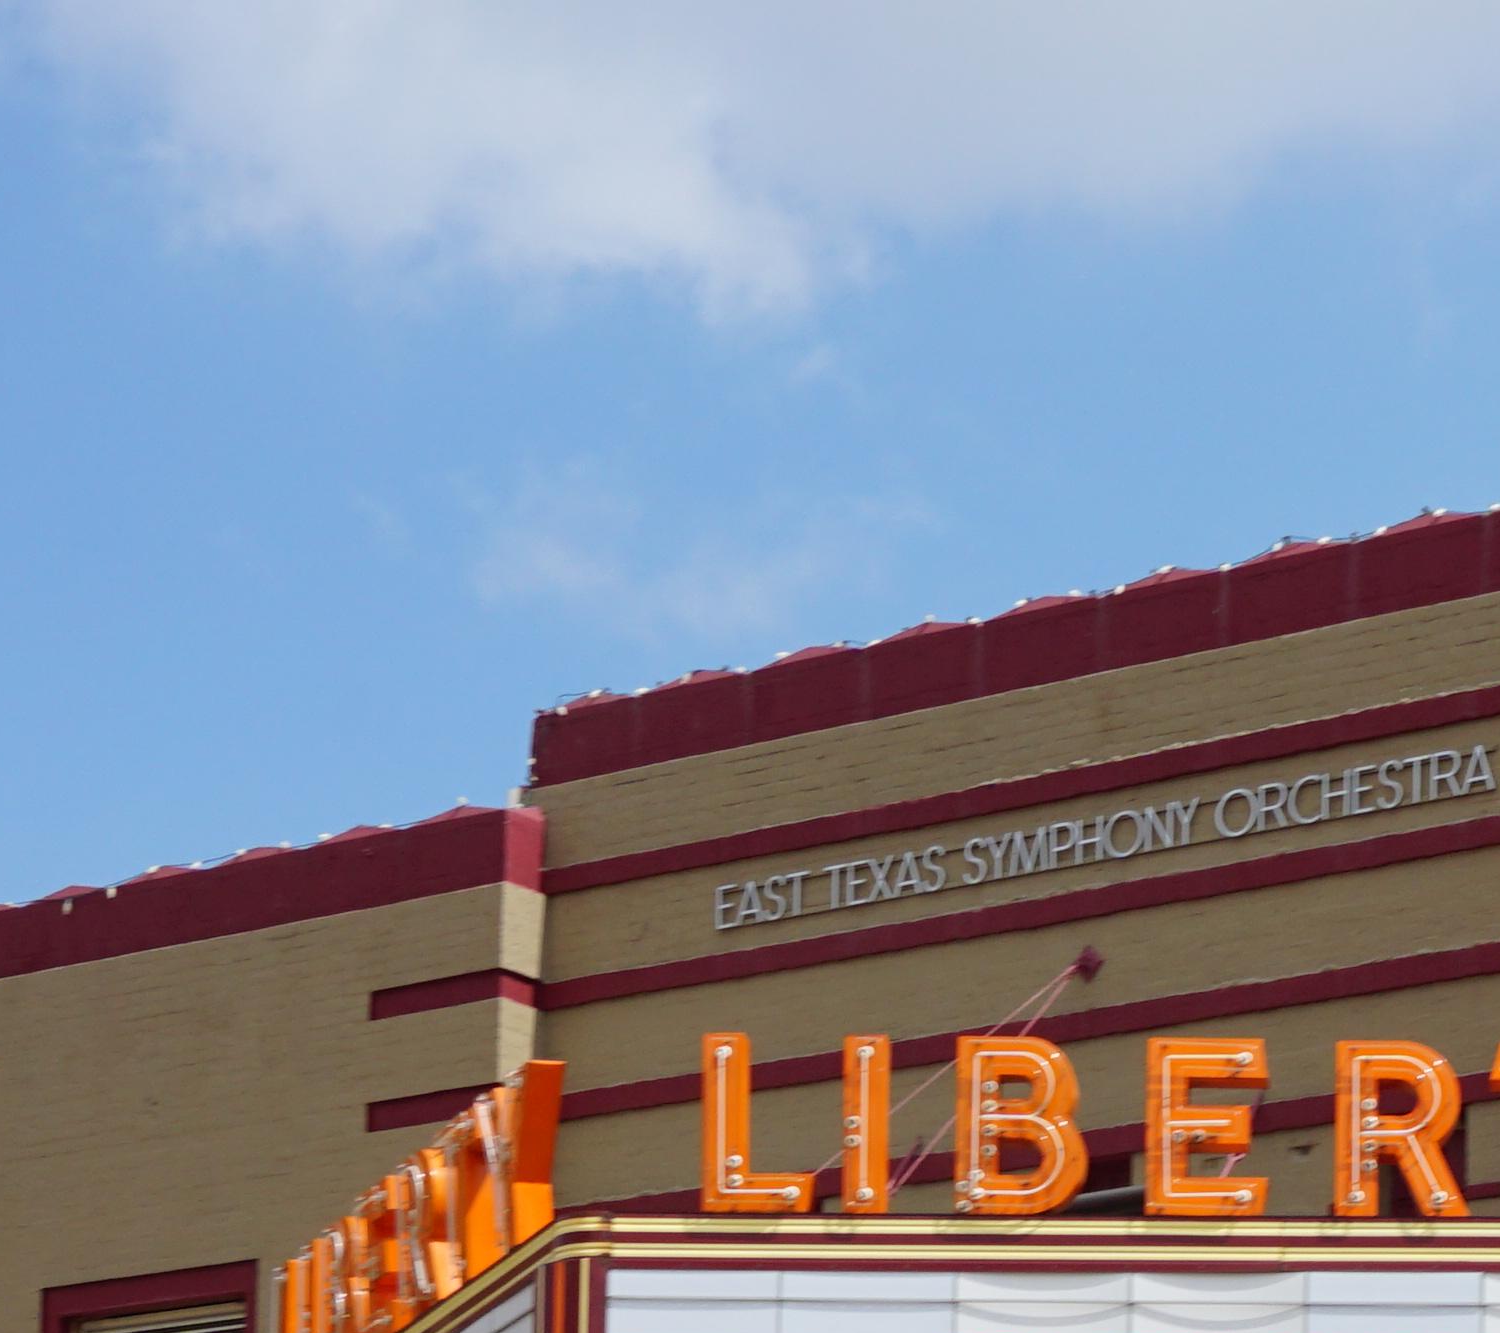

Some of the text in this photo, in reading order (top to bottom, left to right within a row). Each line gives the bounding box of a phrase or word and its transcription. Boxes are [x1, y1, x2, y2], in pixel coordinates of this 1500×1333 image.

[715, 744, 1498, 930] EAST TEXAS SYMPHONY ORCHESTRA
